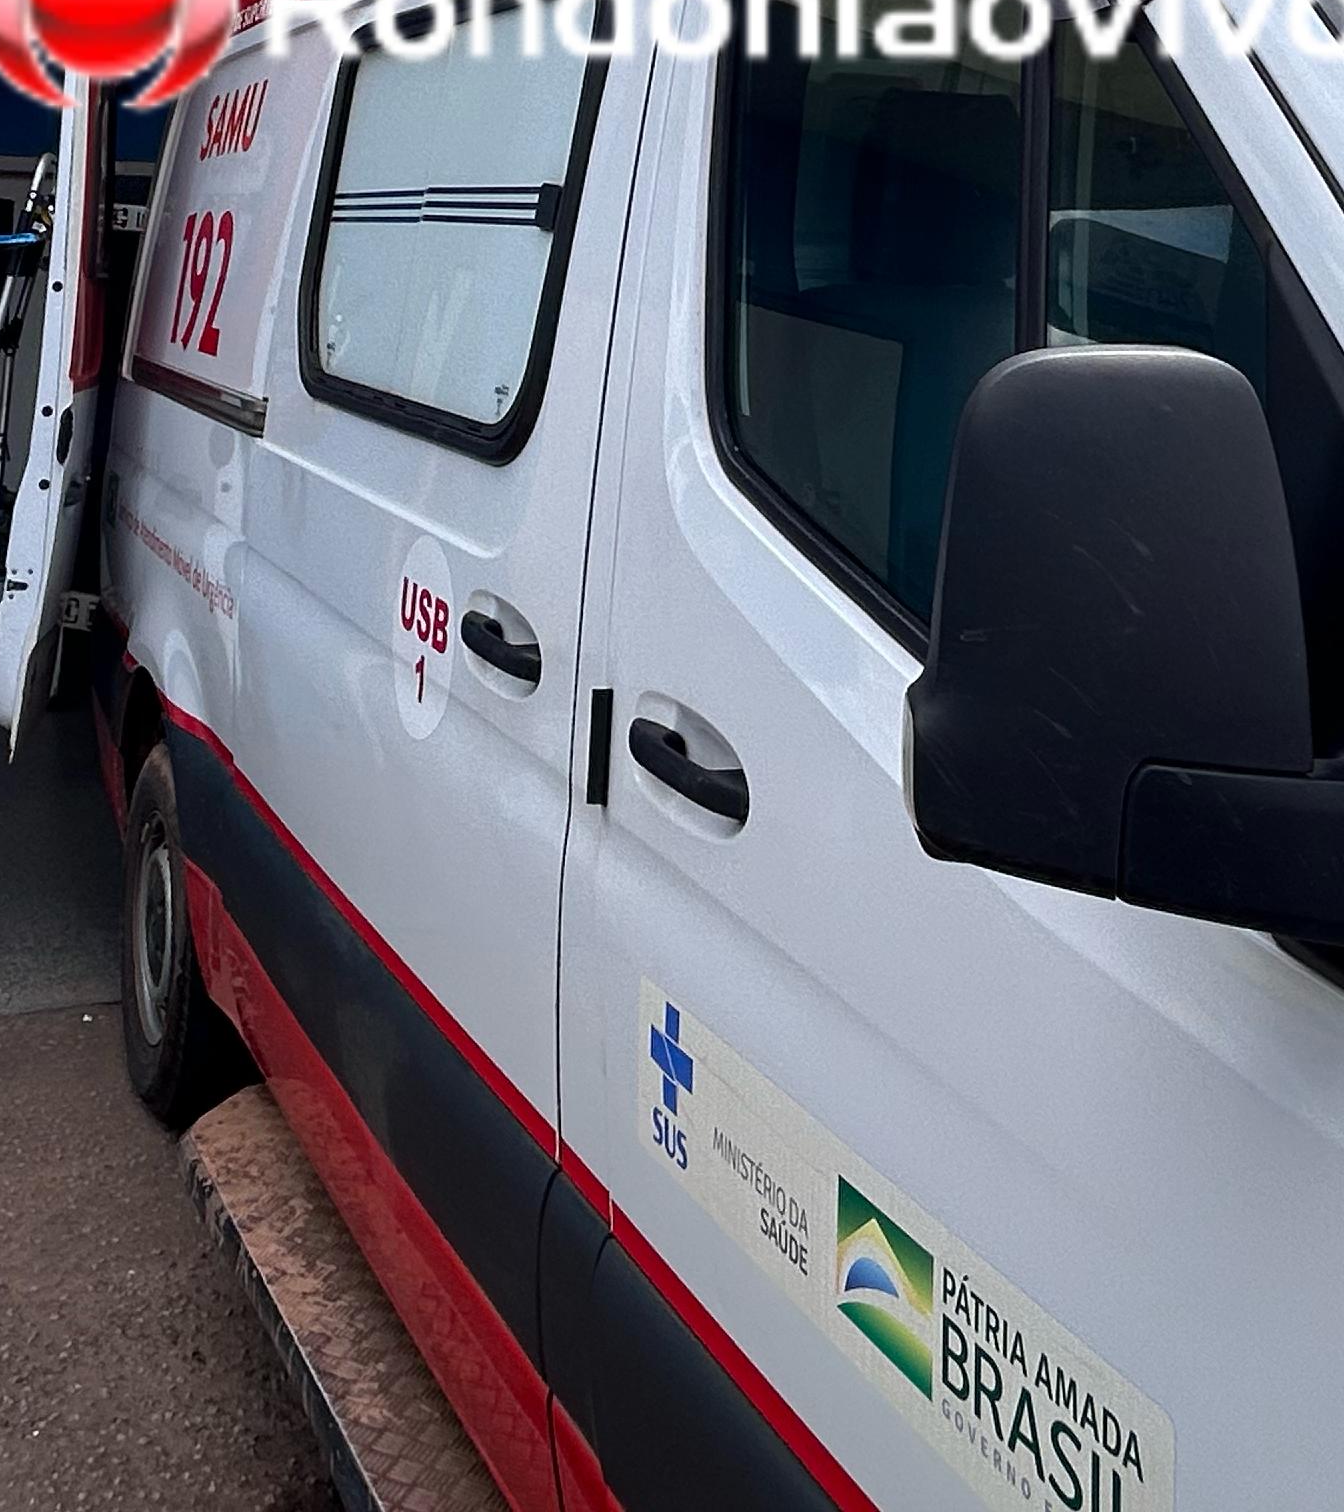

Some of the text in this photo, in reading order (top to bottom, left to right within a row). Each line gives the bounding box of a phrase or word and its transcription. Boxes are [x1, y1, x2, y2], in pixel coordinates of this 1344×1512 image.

[200, 79, 269, 162] SAMU
[170, 209, 235, 358] 192
[400, 577, 449, 655] USB
[414, 655, 426, 703] 1
[652, 1107, 689, 1171] SUS
[712, 1127, 809, 1240] MINISTÉRIO DA
[760, 1207, 809, 1276] SAÚDE
[942, 1266, 1144, 1483] PÁTRIA AMADA
[941, 1398, 1032, 1500] GOVERNO
